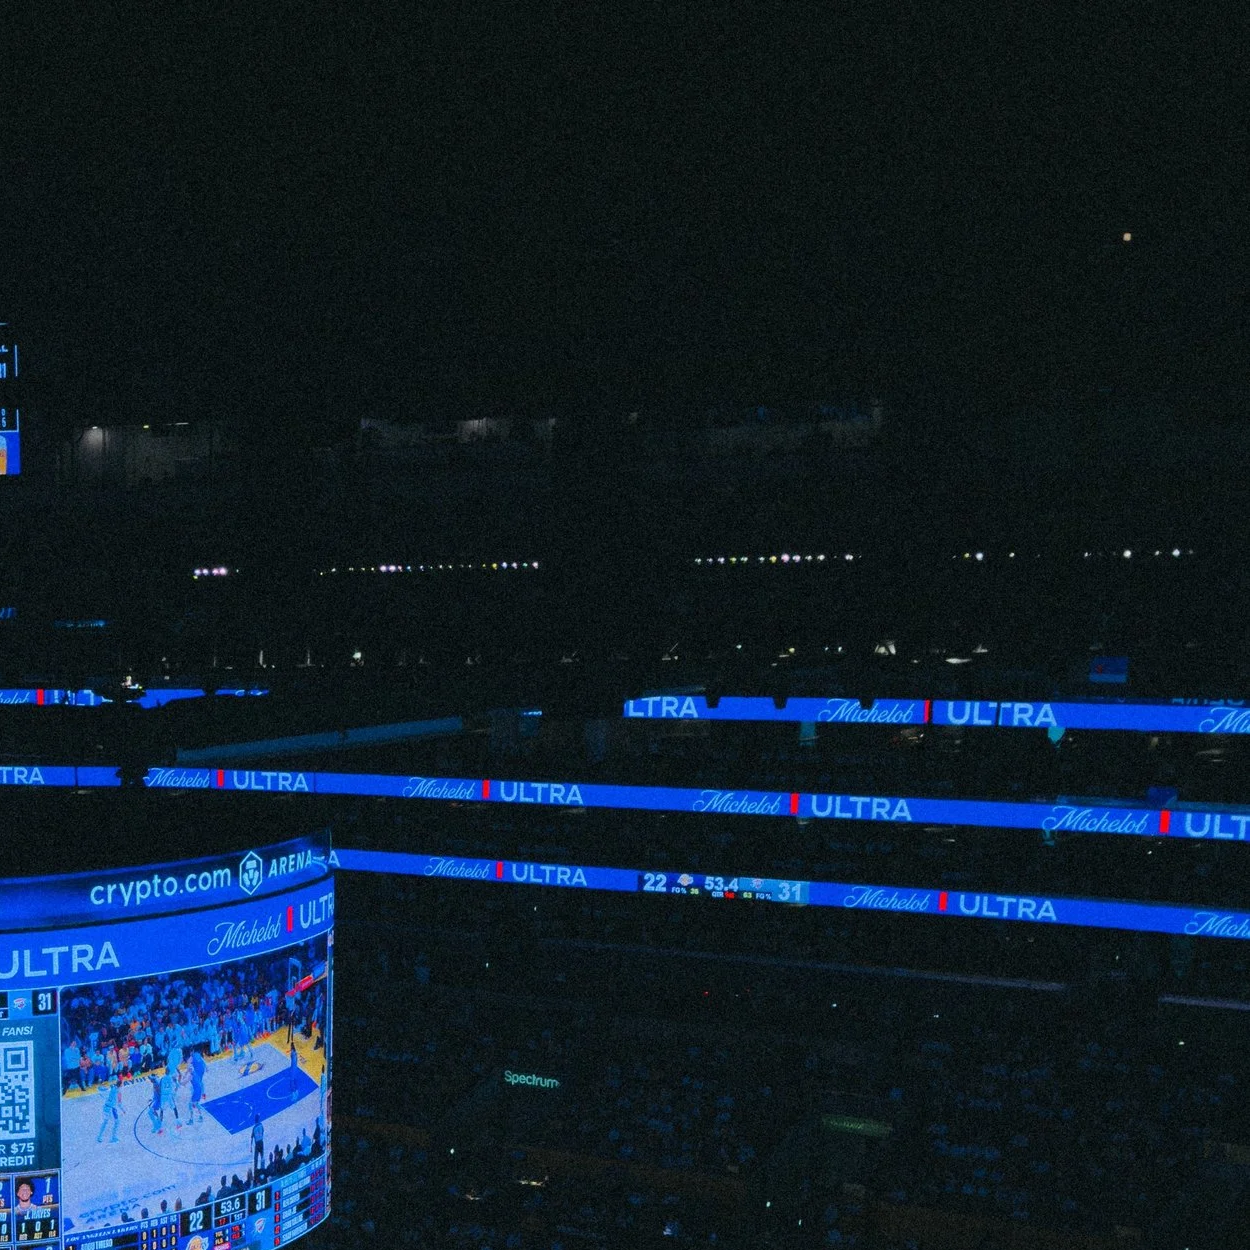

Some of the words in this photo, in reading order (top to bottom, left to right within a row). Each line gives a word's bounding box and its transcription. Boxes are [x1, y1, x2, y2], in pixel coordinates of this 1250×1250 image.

[626, 696, 698, 719] LTRA
[818, 697, 914, 724] Michelob
[947, 700, 1058, 728] ULTRA
[145, 767, 211, 788] Michelob
[233, 771, 309, 792] ULTRA
[402, 776, 475, 799] Michelob
[500, 782, 584, 805] ULTRA
[692, 789, 782, 816] Michelob
[811, 794, 912, 821] ULTRA
[1041, 805, 1148, 835] Michelob
[1185, 813, 1250, 840] ULT
[90, 866, 231, 907] crypto.com
[268, 849, 312, 878] ARENA
[424, 856, 490, 879] Michelob
[511, 863, 588, 887] ULTRA
[643, 873, 667, 892] 22
[704, 876, 739, 892] 53.4
[778, 882, 802, 901] 31
[844, 886, 930, 911] Michelob
[959, 893, 1057, 921] ULTRA
[207, 914, 282, 956] Michelob
[299, 892, 334, 929] ULTR
[38, 993, 52, 1011] 31
[2, 1025, 34, 1037] FANS!
[504, 1070, 560, 1089] Spectrum
[10, 1142, 35, 1154] $75
[42, 1194, 53, 1205] PTS
[45, 1177, 52, 1194] 1
[189, 1210, 203, 1232] 22
[220, 1198, 240, 1214] 53.6
[255, 1190, 266, 1211] 31
